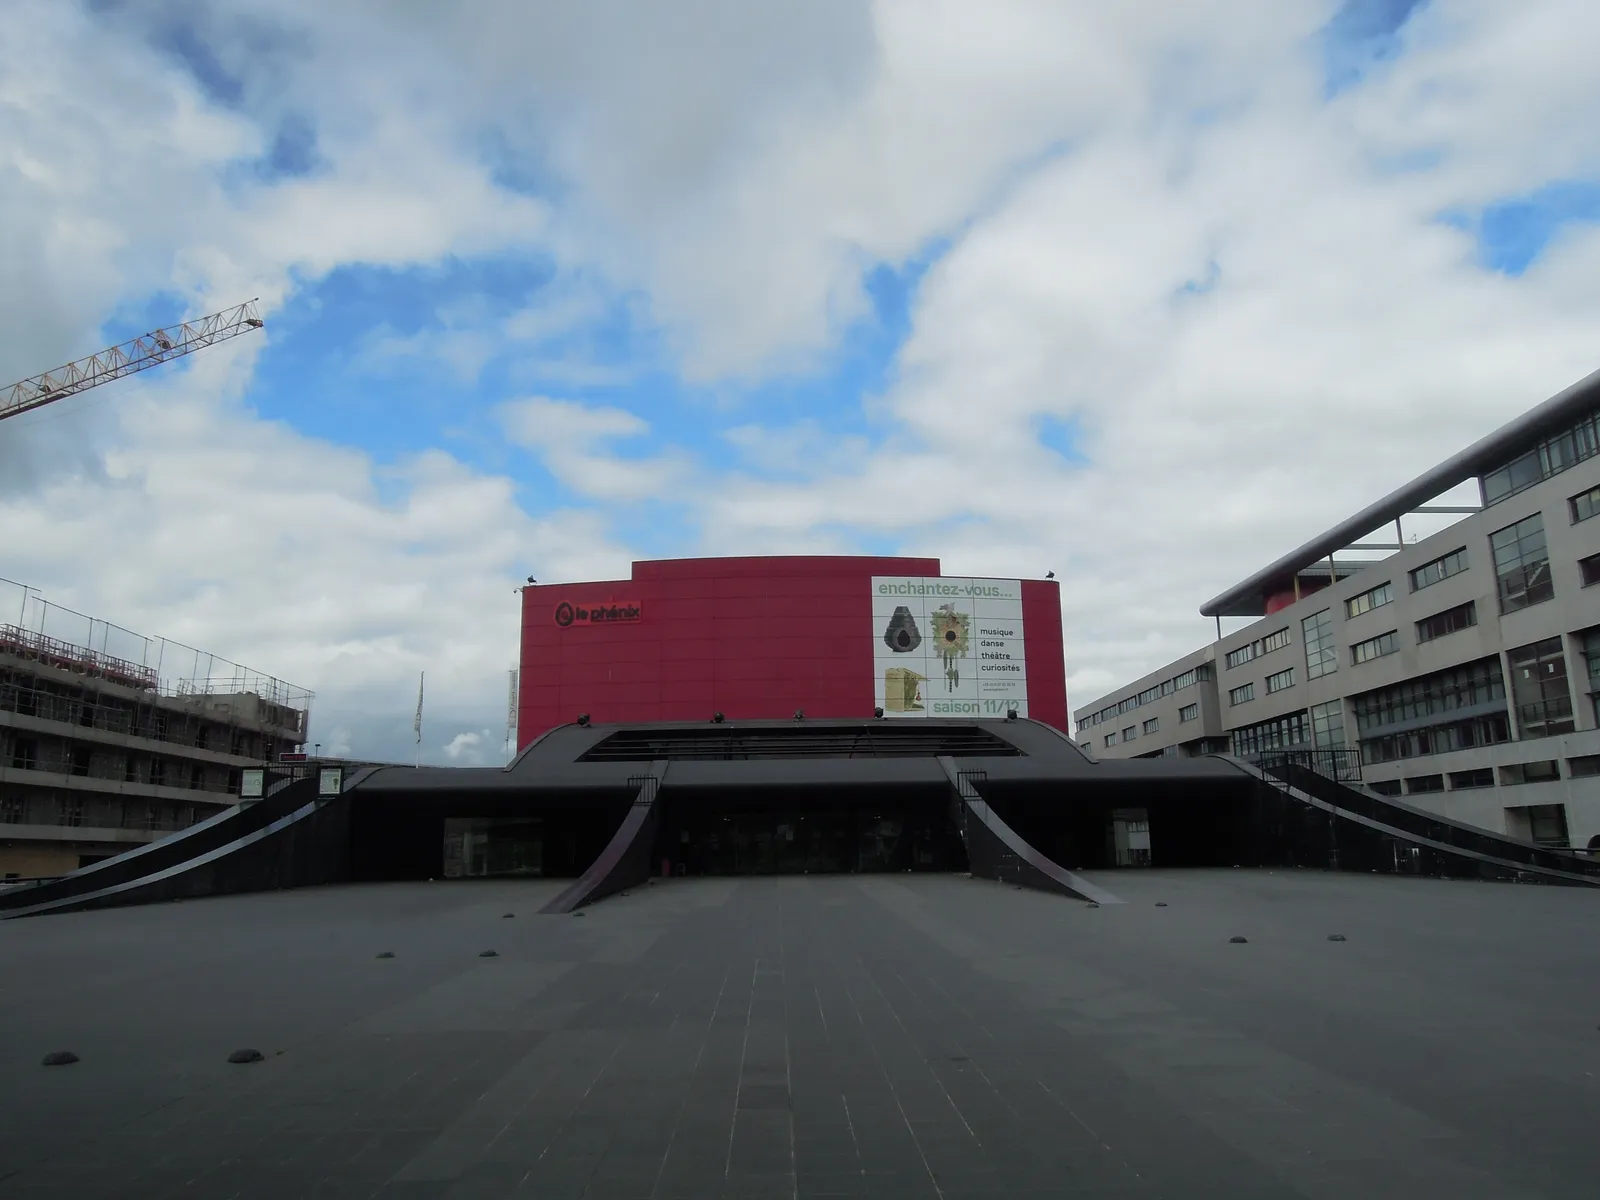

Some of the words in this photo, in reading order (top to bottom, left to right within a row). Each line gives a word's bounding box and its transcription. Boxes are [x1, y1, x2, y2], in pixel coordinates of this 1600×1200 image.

[878, 581, 1013, 597] enchantez-vous...
[576, 606, 589, 620] le
[590, 604, 640, 622] phénix
[980, 628, 1014, 638] musique
[980, 639, 1005, 648] danse
[981, 651, 1011, 660] théâtre
[981, 663, 1021, 672] curiosités
[933, 700, 980, 714] saison
[983, 700, 1020, 714] 11/12
